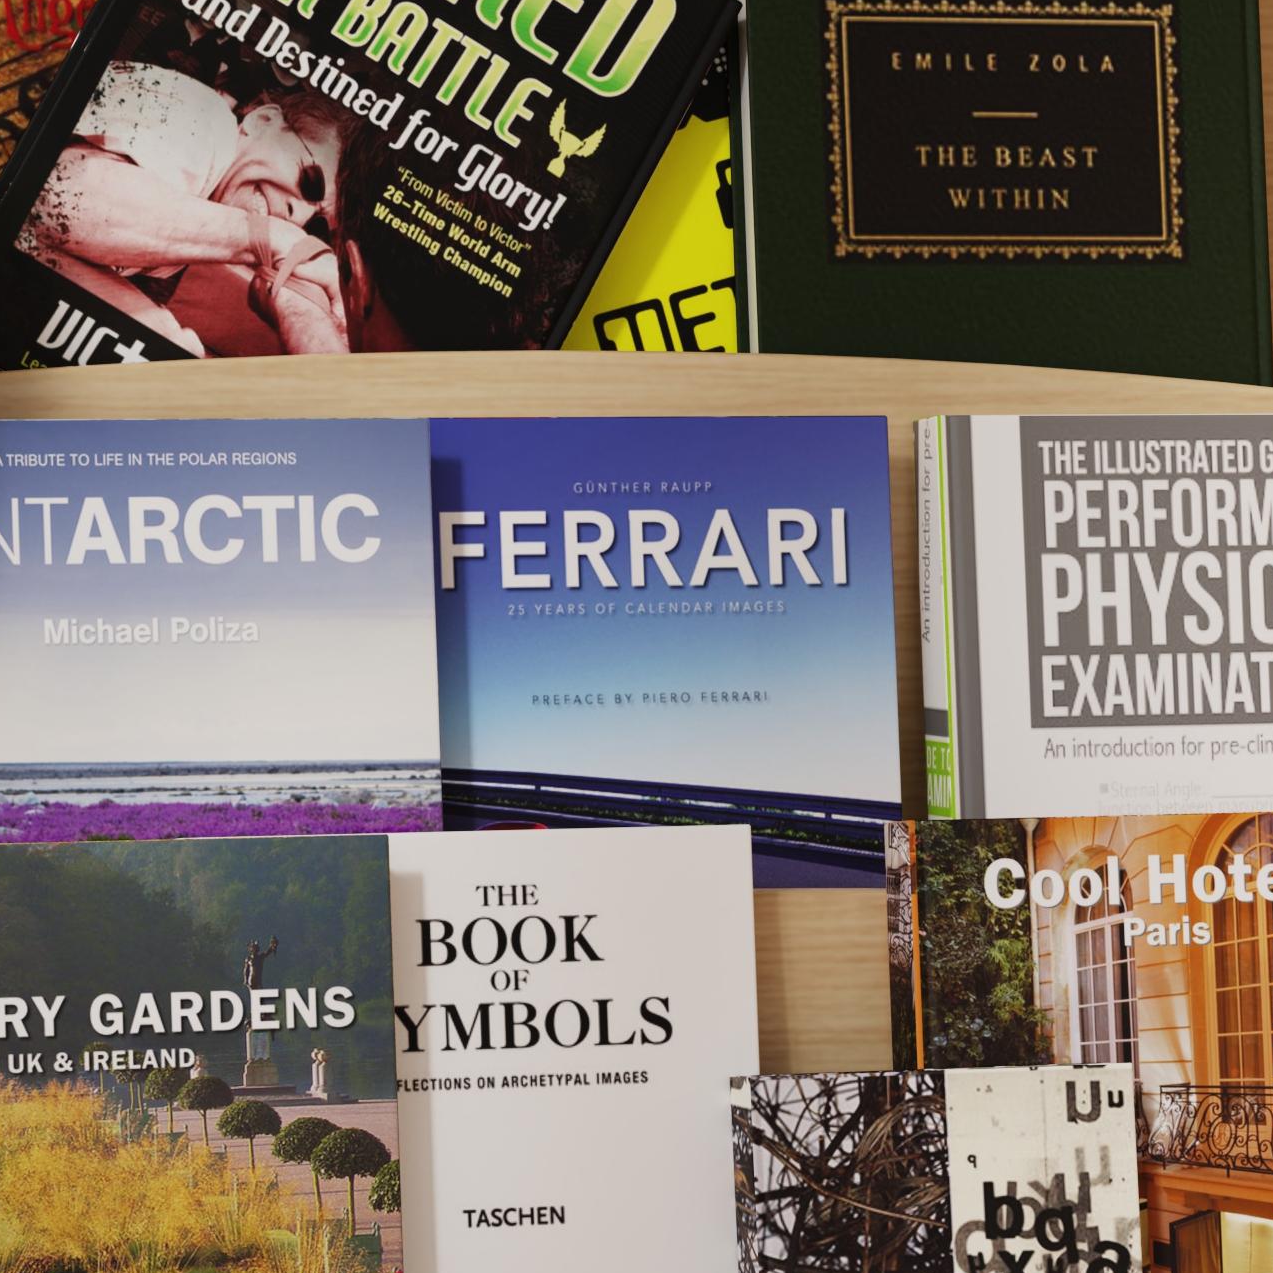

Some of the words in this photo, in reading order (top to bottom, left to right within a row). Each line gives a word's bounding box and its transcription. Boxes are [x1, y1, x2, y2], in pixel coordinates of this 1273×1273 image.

[891, 52, 998, 72] EMILE
[1029, 53, 1115, 73] ZOLA
[388, 108, 460, 163] for
[454, 143, 567, 231] Glory!
[915, 145, 978, 168] THE
[995, 145, 1099, 169] BEAST
[435, 188, 474, 223] Victim
[474, 214, 488, 232] to
[948, 187, 1071, 210] WITHIN
[373, 202, 441, 255] Wrestling
[442, 245, 513, 298] Champion
[448, 224, 491, 259] World
[491, 251, 522, 279] Arm
[6, 453, 65, 467] TRIBUTE
[69, 453, 90, 467] TO
[94, 453, 124, 466] LIFE
[127, 453, 143, 466] IN
[146, 452, 175, 466] THE
[178, 452, 228, 466] POLAR
[231, 451, 297, 465] REGIONS
[1038, 440, 1087, 475] THE
[1093, 438, 1253, 474] ILLUSTRATED
[660, 481, 713, 494] RAUPP
[922, 469, 931, 492] for
[438, 508, 848, 590] FERRARI
[922, 499, 931, 617] introduction
[507, 604, 525, 616] 25
[534, 603, 586, 615] YEARS
[594, 602, 617, 615] OF
[624, 601, 714, 615] CALENDAR
[722, 600, 786, 613] IMAGES
[43, 617, 159, 645] Michael
[170, 616, 259, 642] Poliza
[531, 693, 605, 706] PREFACE
[614, 693, 632, 705] BY
[642, 691, 691, 704] PIERO
[700, 690, 769, 703] FERRARI
[1043, 737, 1067, 758] An
[1071, 734, 1175, 758] introduction
[1180, 734, 1203, 756] for
[475, 884, 539, 907] THE
[983, 855, 1121, 910] Cool
[415, 914, 605, 967] BOOK
[1123, 914, 1212, 947] Paris
[490, 969, 530, 992] OF
[90, 985, 356, 1038] GARDENS
[394, 997, 674, 1053] YMBOLS
[7, 1051, 45, 1075] UK
[52, 1050, 74, 1073] &
[83, 1047, 197, 1072] IRELAND
[396, 1076, 471, 1092] FLECTIONS
[477, 1075, 496, 1089] ON
[501, 1073, 591, 1088] ARCHETYPAL
[596, 1070, 649, 1085] IMAGES
[463, 1205, 566, 1228] TASCHEN
